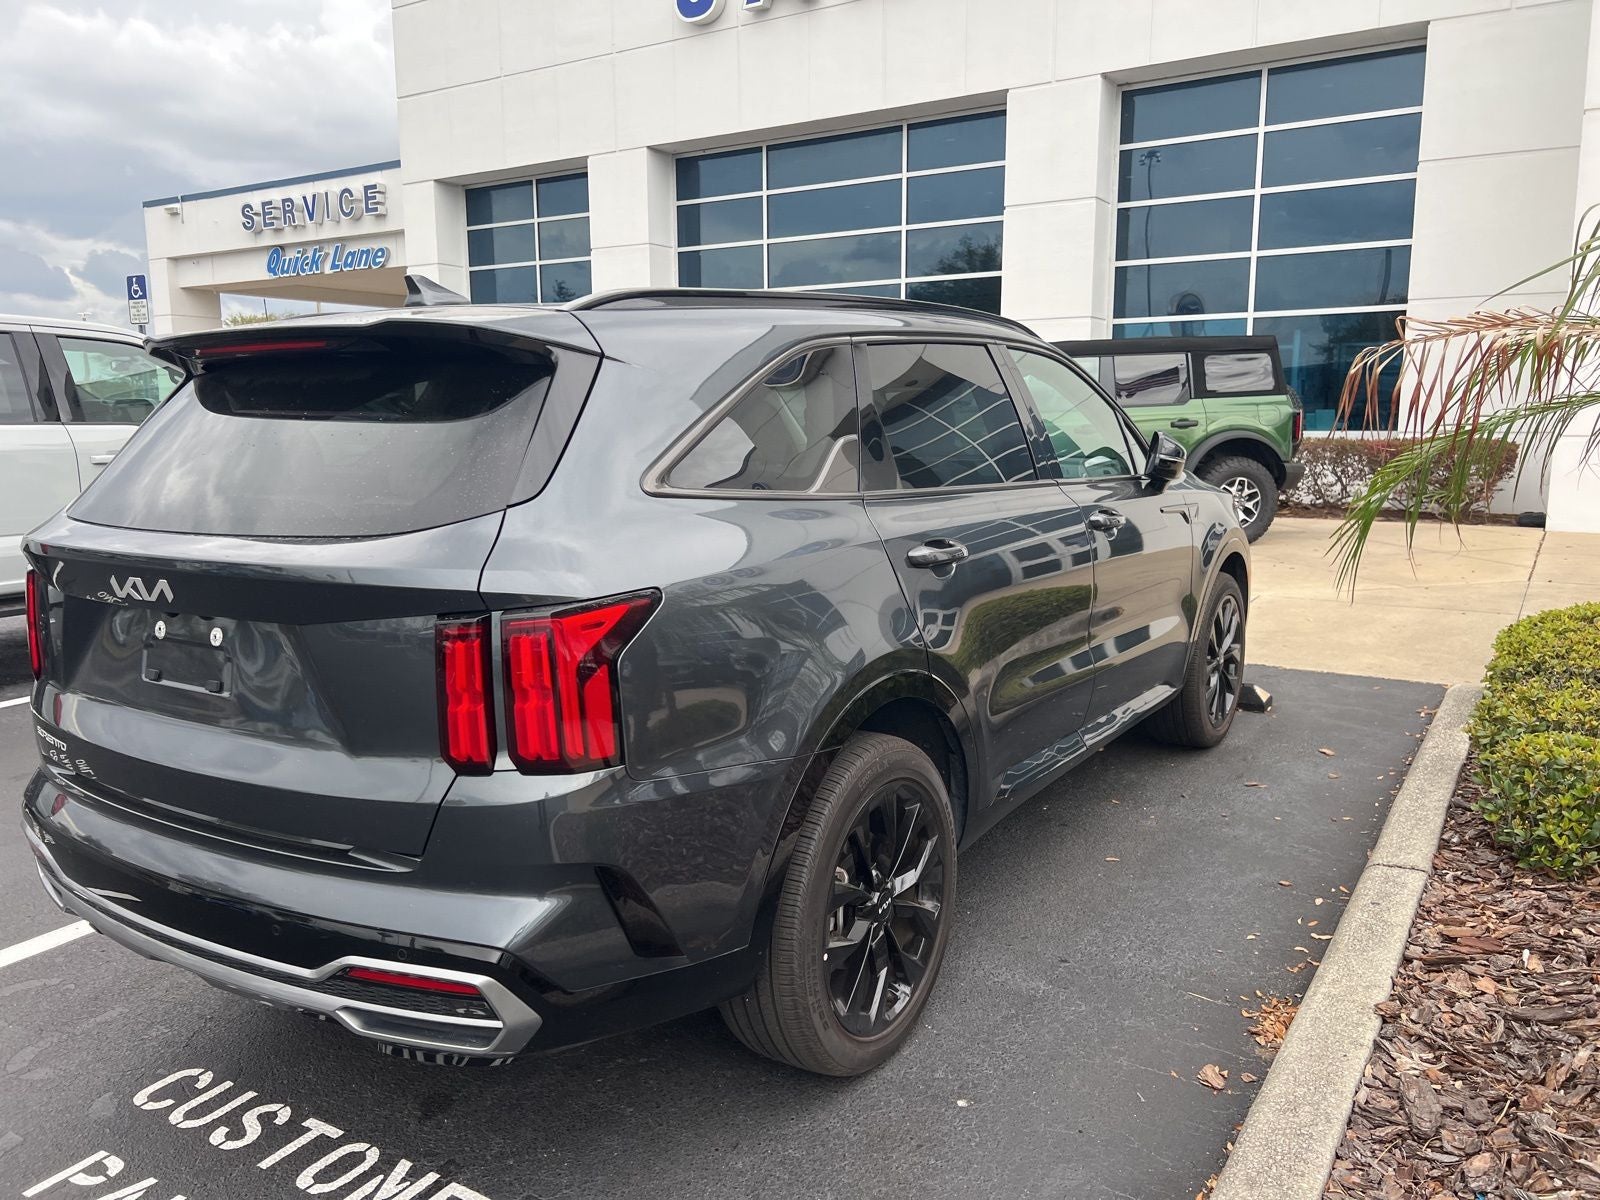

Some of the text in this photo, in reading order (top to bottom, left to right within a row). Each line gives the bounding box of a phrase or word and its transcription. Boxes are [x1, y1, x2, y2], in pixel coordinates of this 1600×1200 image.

[241, 184, 386, 232] SERVICE
[266, 243, 388, 278] Quick Lane
